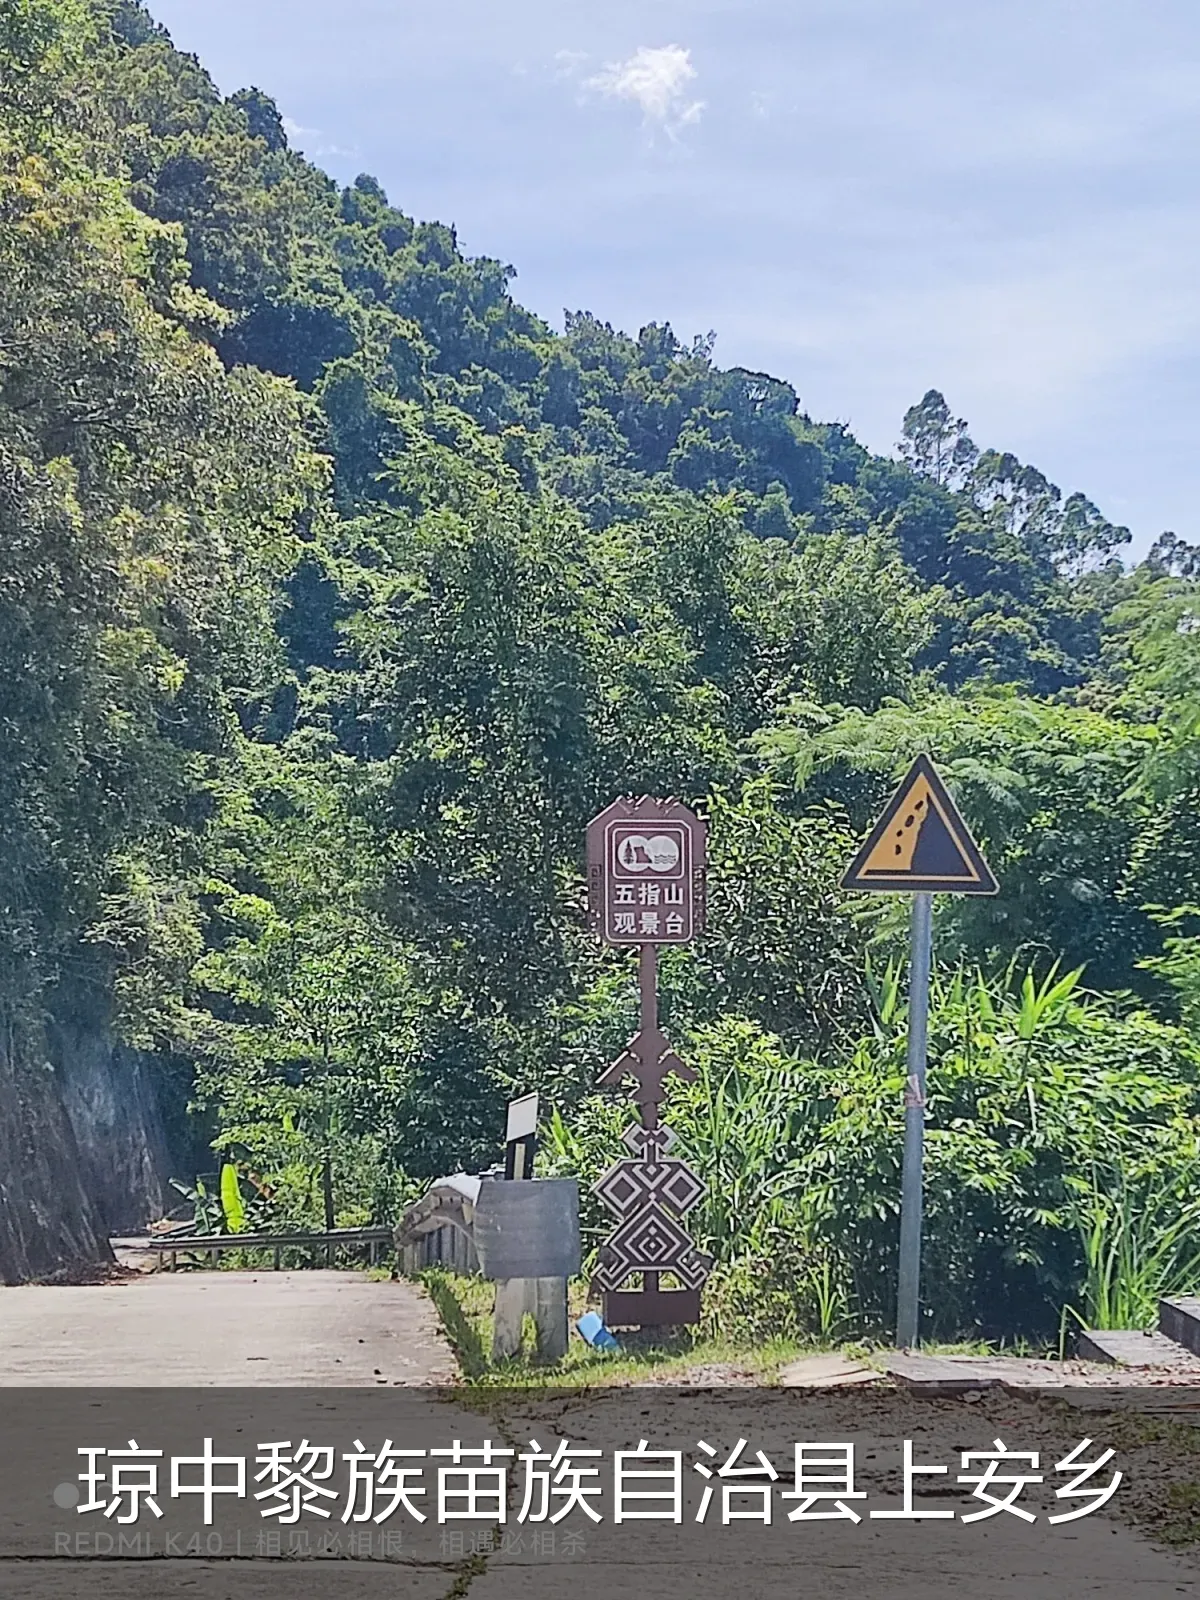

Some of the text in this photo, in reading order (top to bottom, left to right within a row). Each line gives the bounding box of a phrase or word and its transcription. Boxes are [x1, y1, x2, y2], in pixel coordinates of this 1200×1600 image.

[613, 883, 684, 906] 五指山
[613, 911, 684, 935] 观景台
